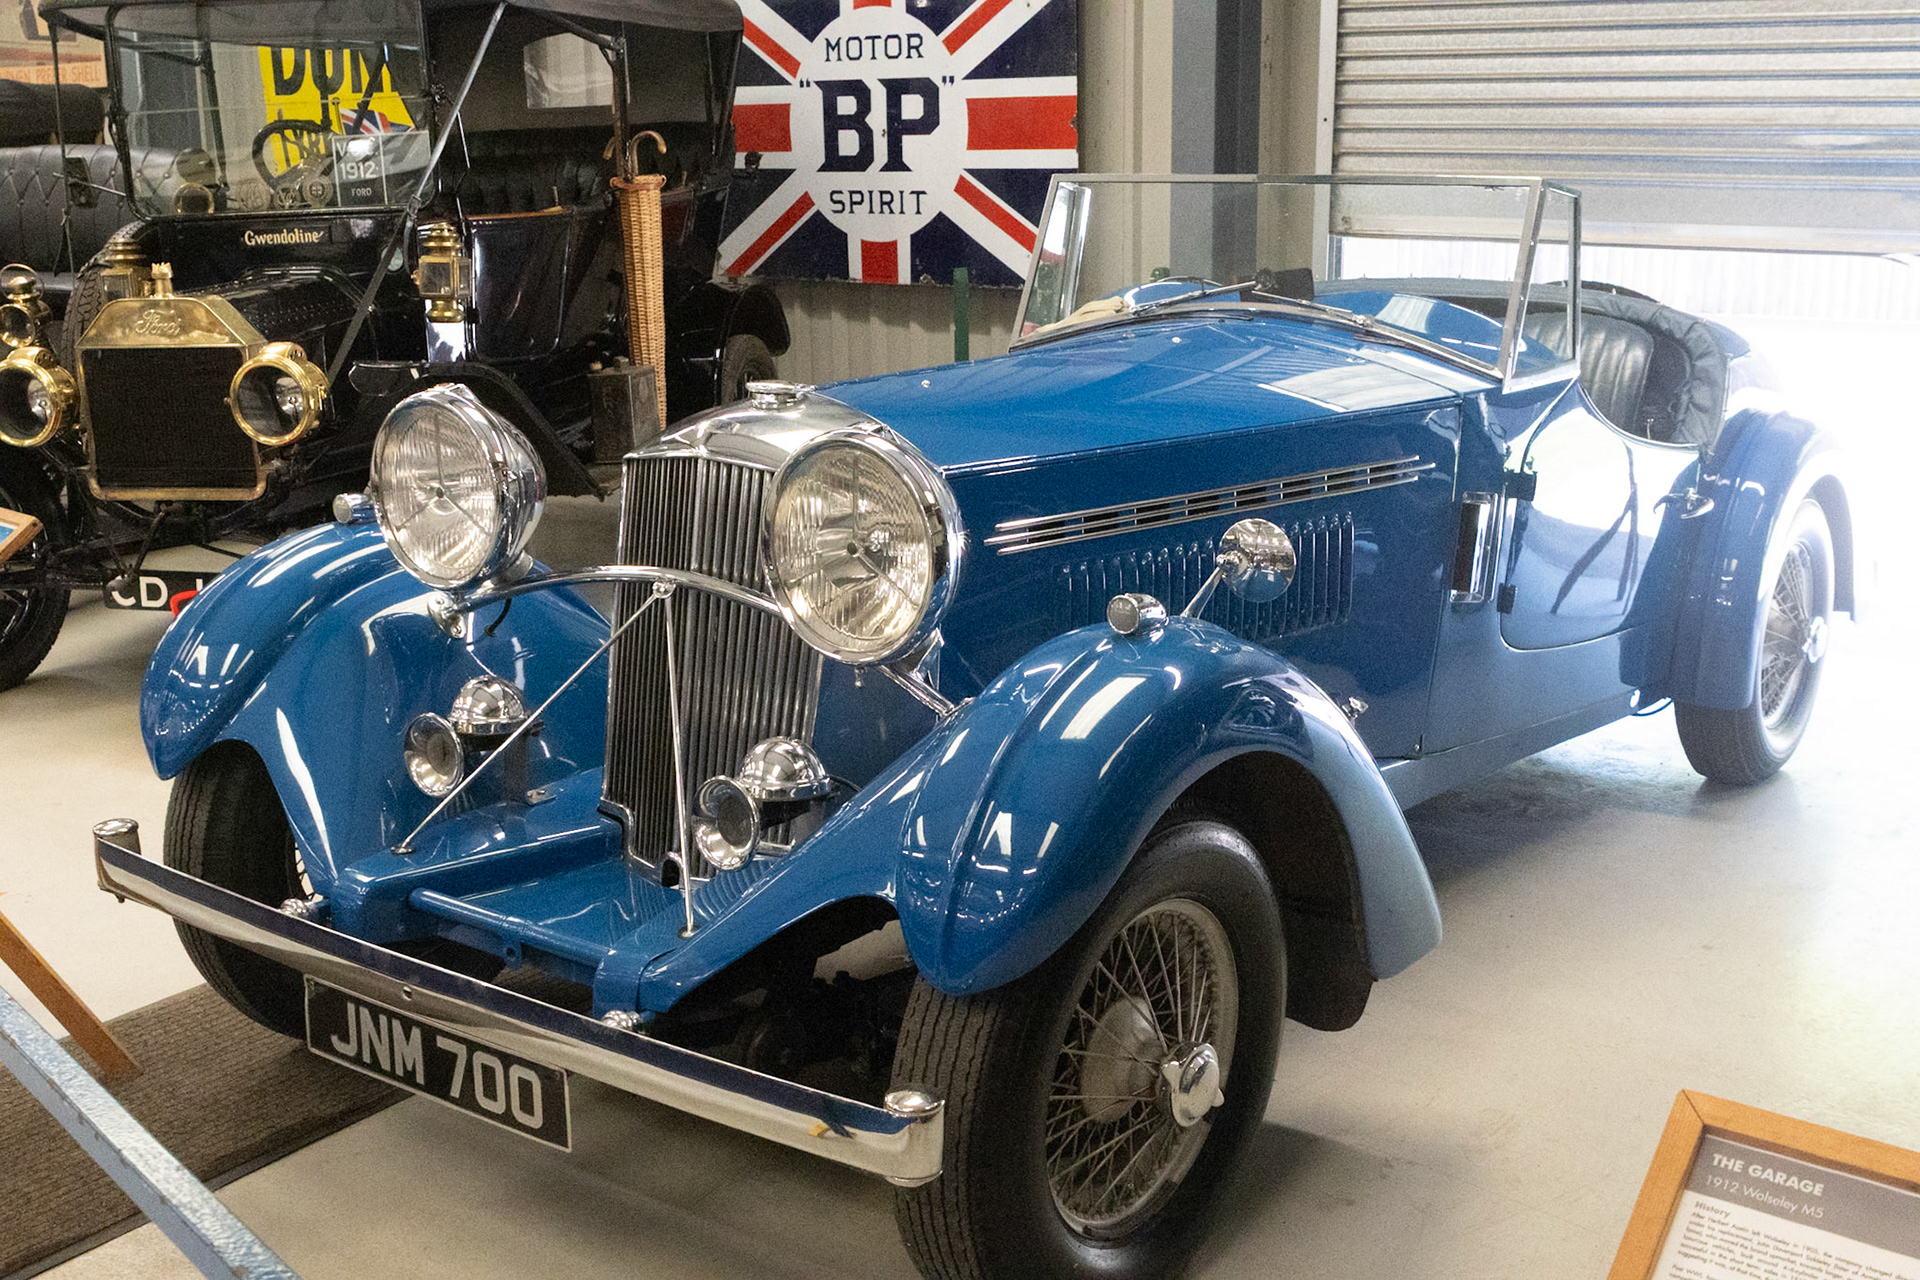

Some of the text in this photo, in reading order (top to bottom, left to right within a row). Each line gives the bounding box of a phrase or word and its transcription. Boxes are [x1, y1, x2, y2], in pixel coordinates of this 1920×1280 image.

[824, 33, 924, 62] MOTOR
[72, 64, 101, 82] SHELL
[340, 160, 378, 180] 1912
[351, 187, 373, 197] FORD
[829, 190, 928, 215] SPIRIT
[244, 228, 325, 246] Gwendoline
[135, 309, 181, 335] Ford
[331, 1002, 543, 1129] JNM 700
[1713, 1154, 1825, 1196] THE GARAGE
[1706, 1175, 1824, 1218] 1912 Wolseley M5
[1695, 1202, 1731, 1218] History
